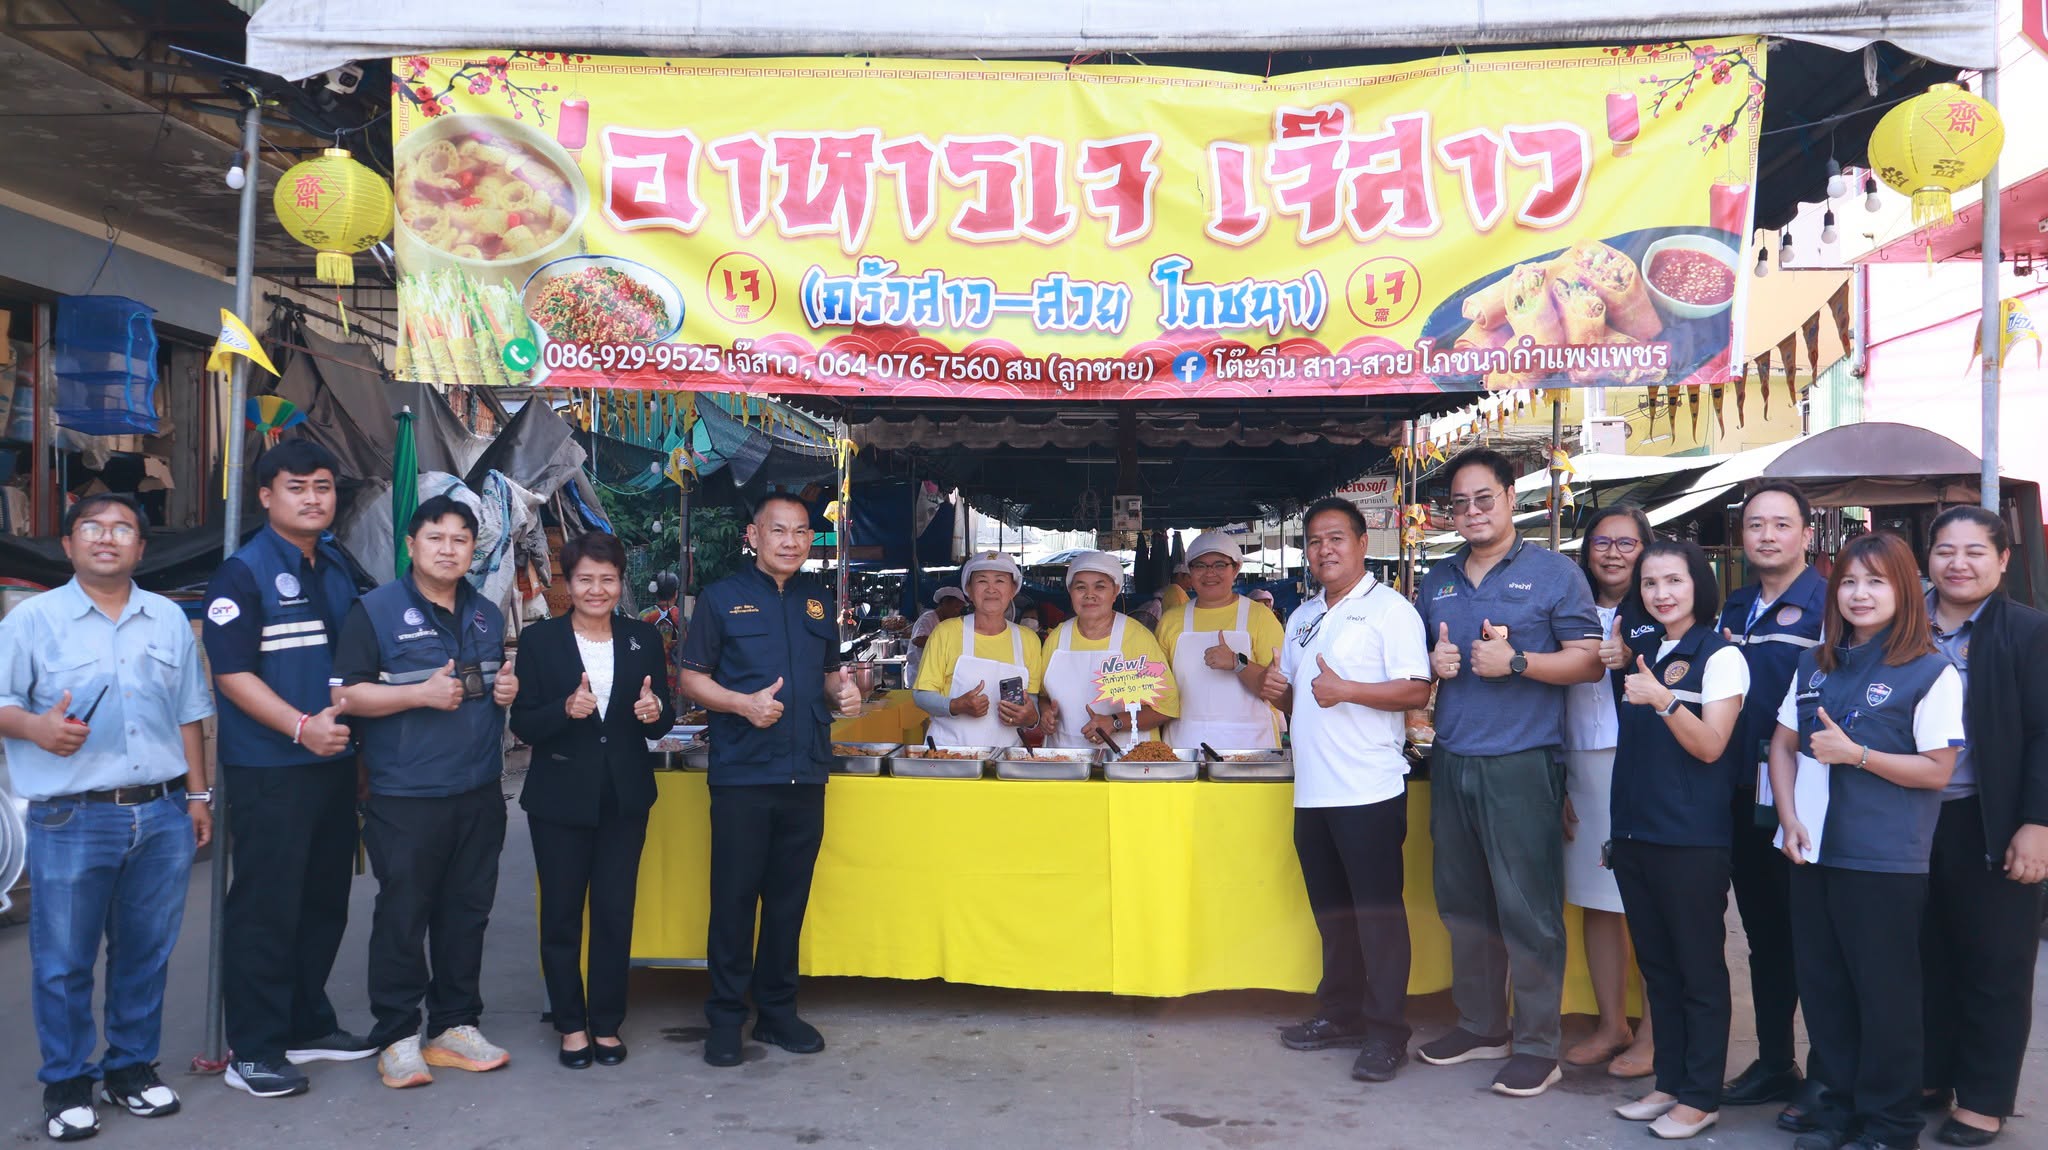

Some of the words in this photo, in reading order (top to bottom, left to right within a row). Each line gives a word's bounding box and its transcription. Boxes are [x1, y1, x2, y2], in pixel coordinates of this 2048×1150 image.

[603, 127, 1162, 252] อาหารเจ
[723, 268, 760, 302] เจ
[1364, 270, 1406, 305] เจ
[547, 344, 720, 371] 086-929-9525
[818, 352, 999, 380] 064-076-7560
[1006, 360, 1041, 380] สม
[1048, 356, 1154, 392] (ลูกชาย)
[1213, 347, 1296, 379] โต๊ะจีน
[1303, 352, 1412, 378] สาว-สวย
[1418, 340, 1506, 373] โภชนา
[1514, 338, 1668, 370] กำแพงเพชร
[1101, 655, 1146, 674] New!
